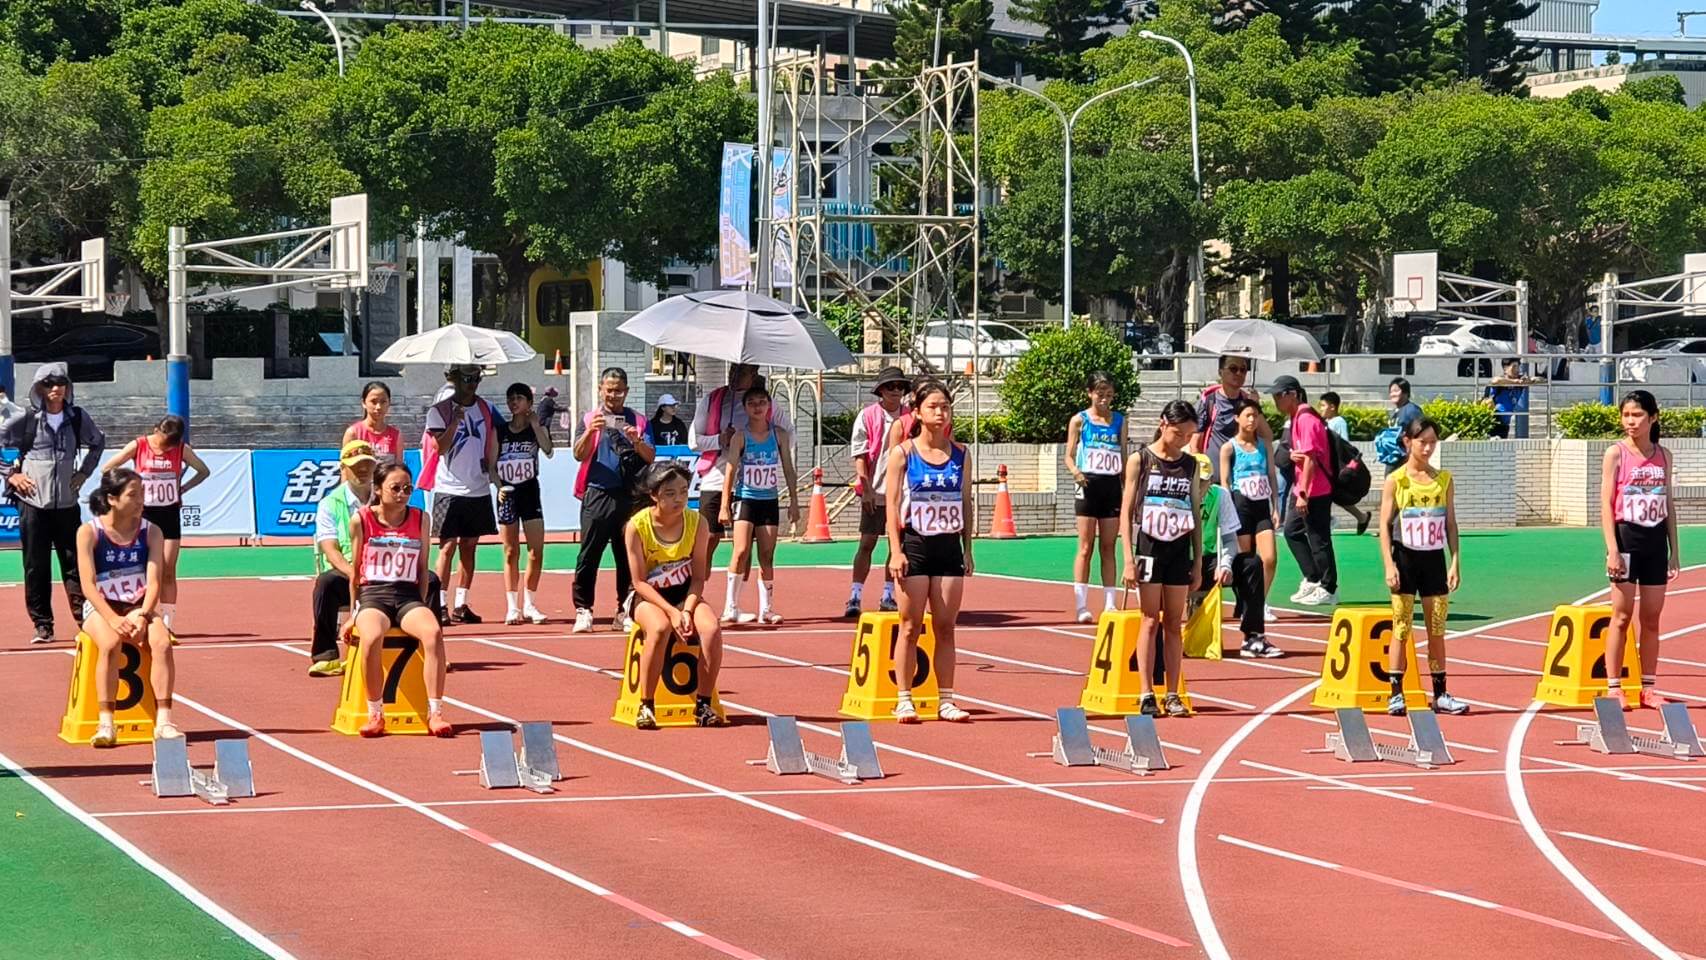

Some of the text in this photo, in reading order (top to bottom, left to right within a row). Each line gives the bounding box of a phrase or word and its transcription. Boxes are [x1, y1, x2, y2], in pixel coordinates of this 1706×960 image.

[500, 462, 533, 481] 1048
[1088, 451, 1119, 472] 1200
[746, 467, 777, 486] 1075
[914, 505, 961, 532] 1258
[1146, 511, 1191, 537] 1034
[1627, 499, 1667, 523] 1364
[1406, 520, 1444, 547] 1184
[370, 551, 417, 578] 1097
[855, 622, 874, 687] 5
[1096, 621, 1115, 684] 4
[1331, 618, 1352, 680] 3
[1550, 616, 1574, 677] 2
[382, 636, 421, 704] 7
[629, 629, 644, 693] 6
[661, 630, 699, 695] 6
